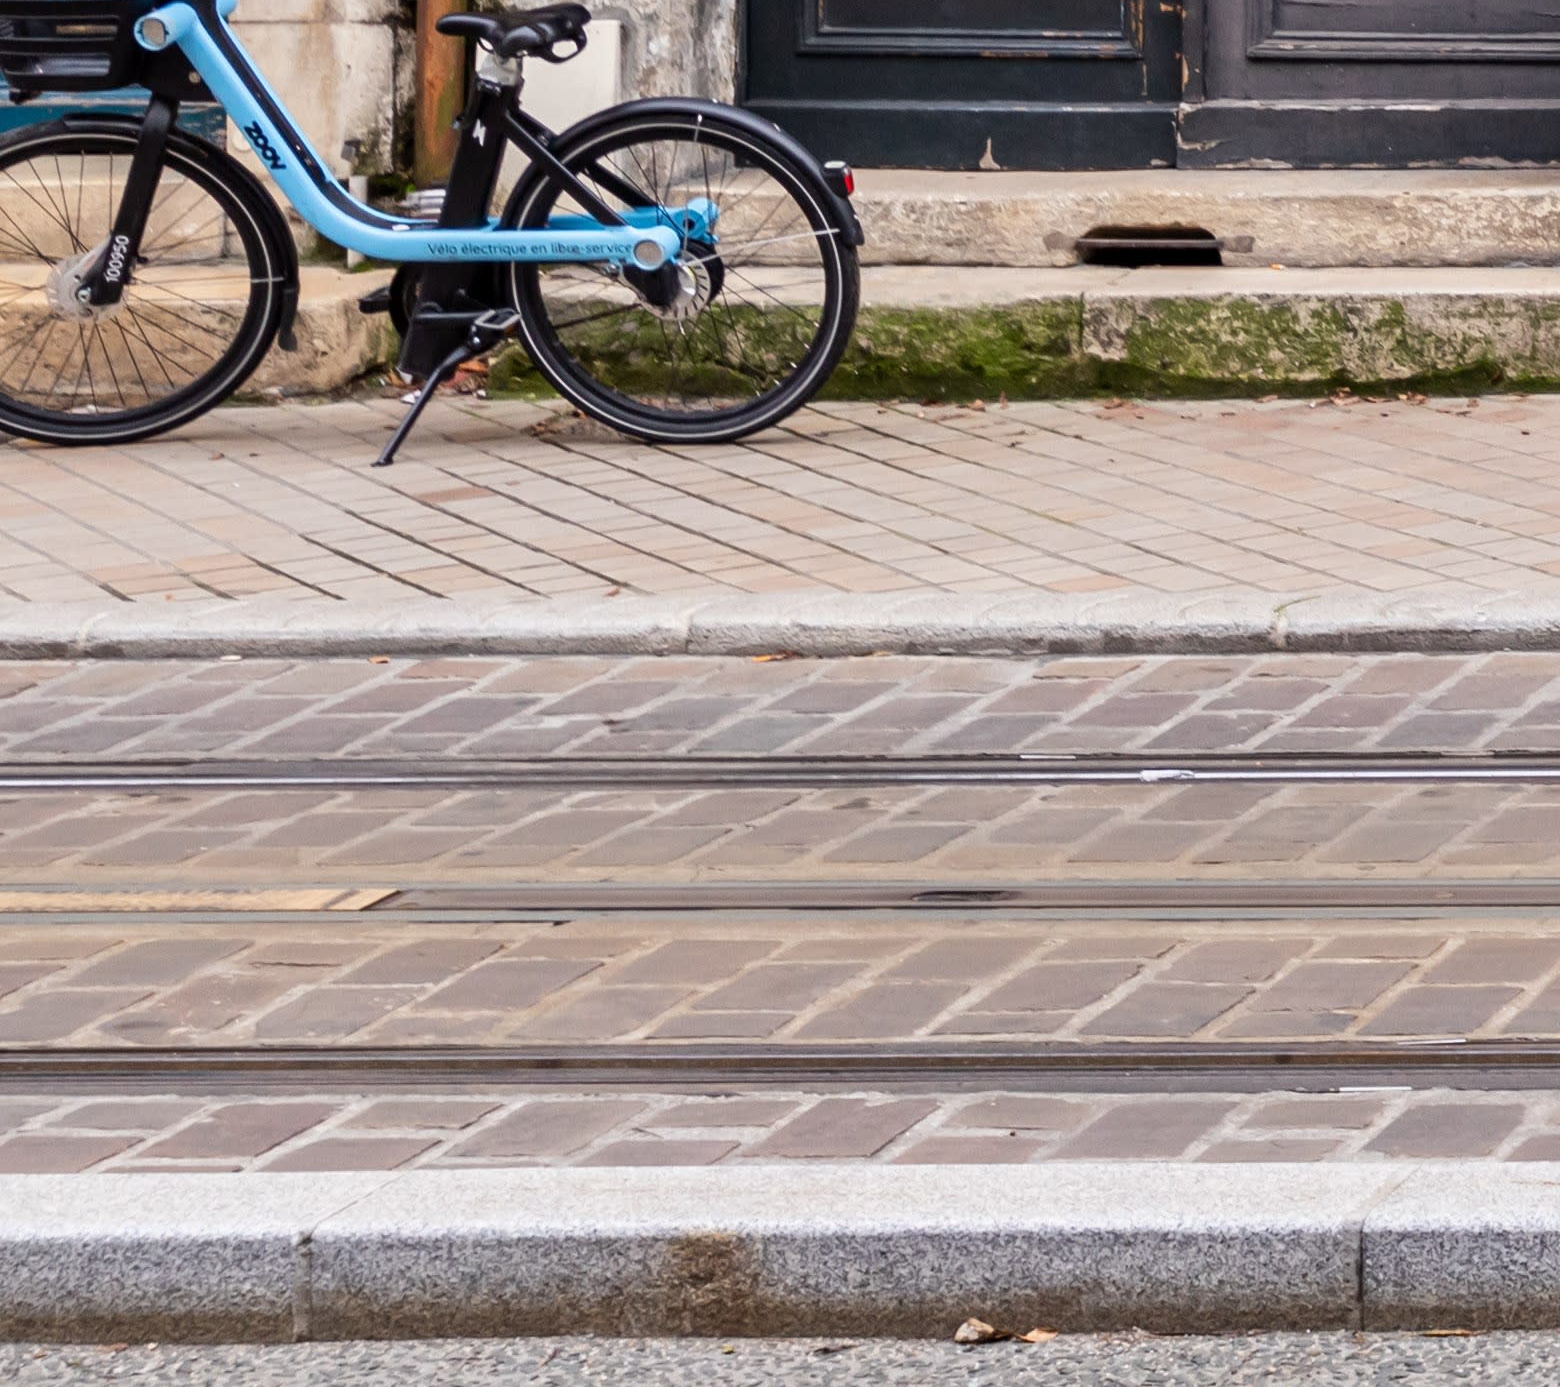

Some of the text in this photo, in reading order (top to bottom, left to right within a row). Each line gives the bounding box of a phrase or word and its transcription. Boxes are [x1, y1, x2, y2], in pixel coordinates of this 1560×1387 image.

[103, 234, 130, 283] 100950
[426, 241, 458, 256] Vélo
[460, 241, 528, 258] électrique
[530, 243, 548, 255] en
